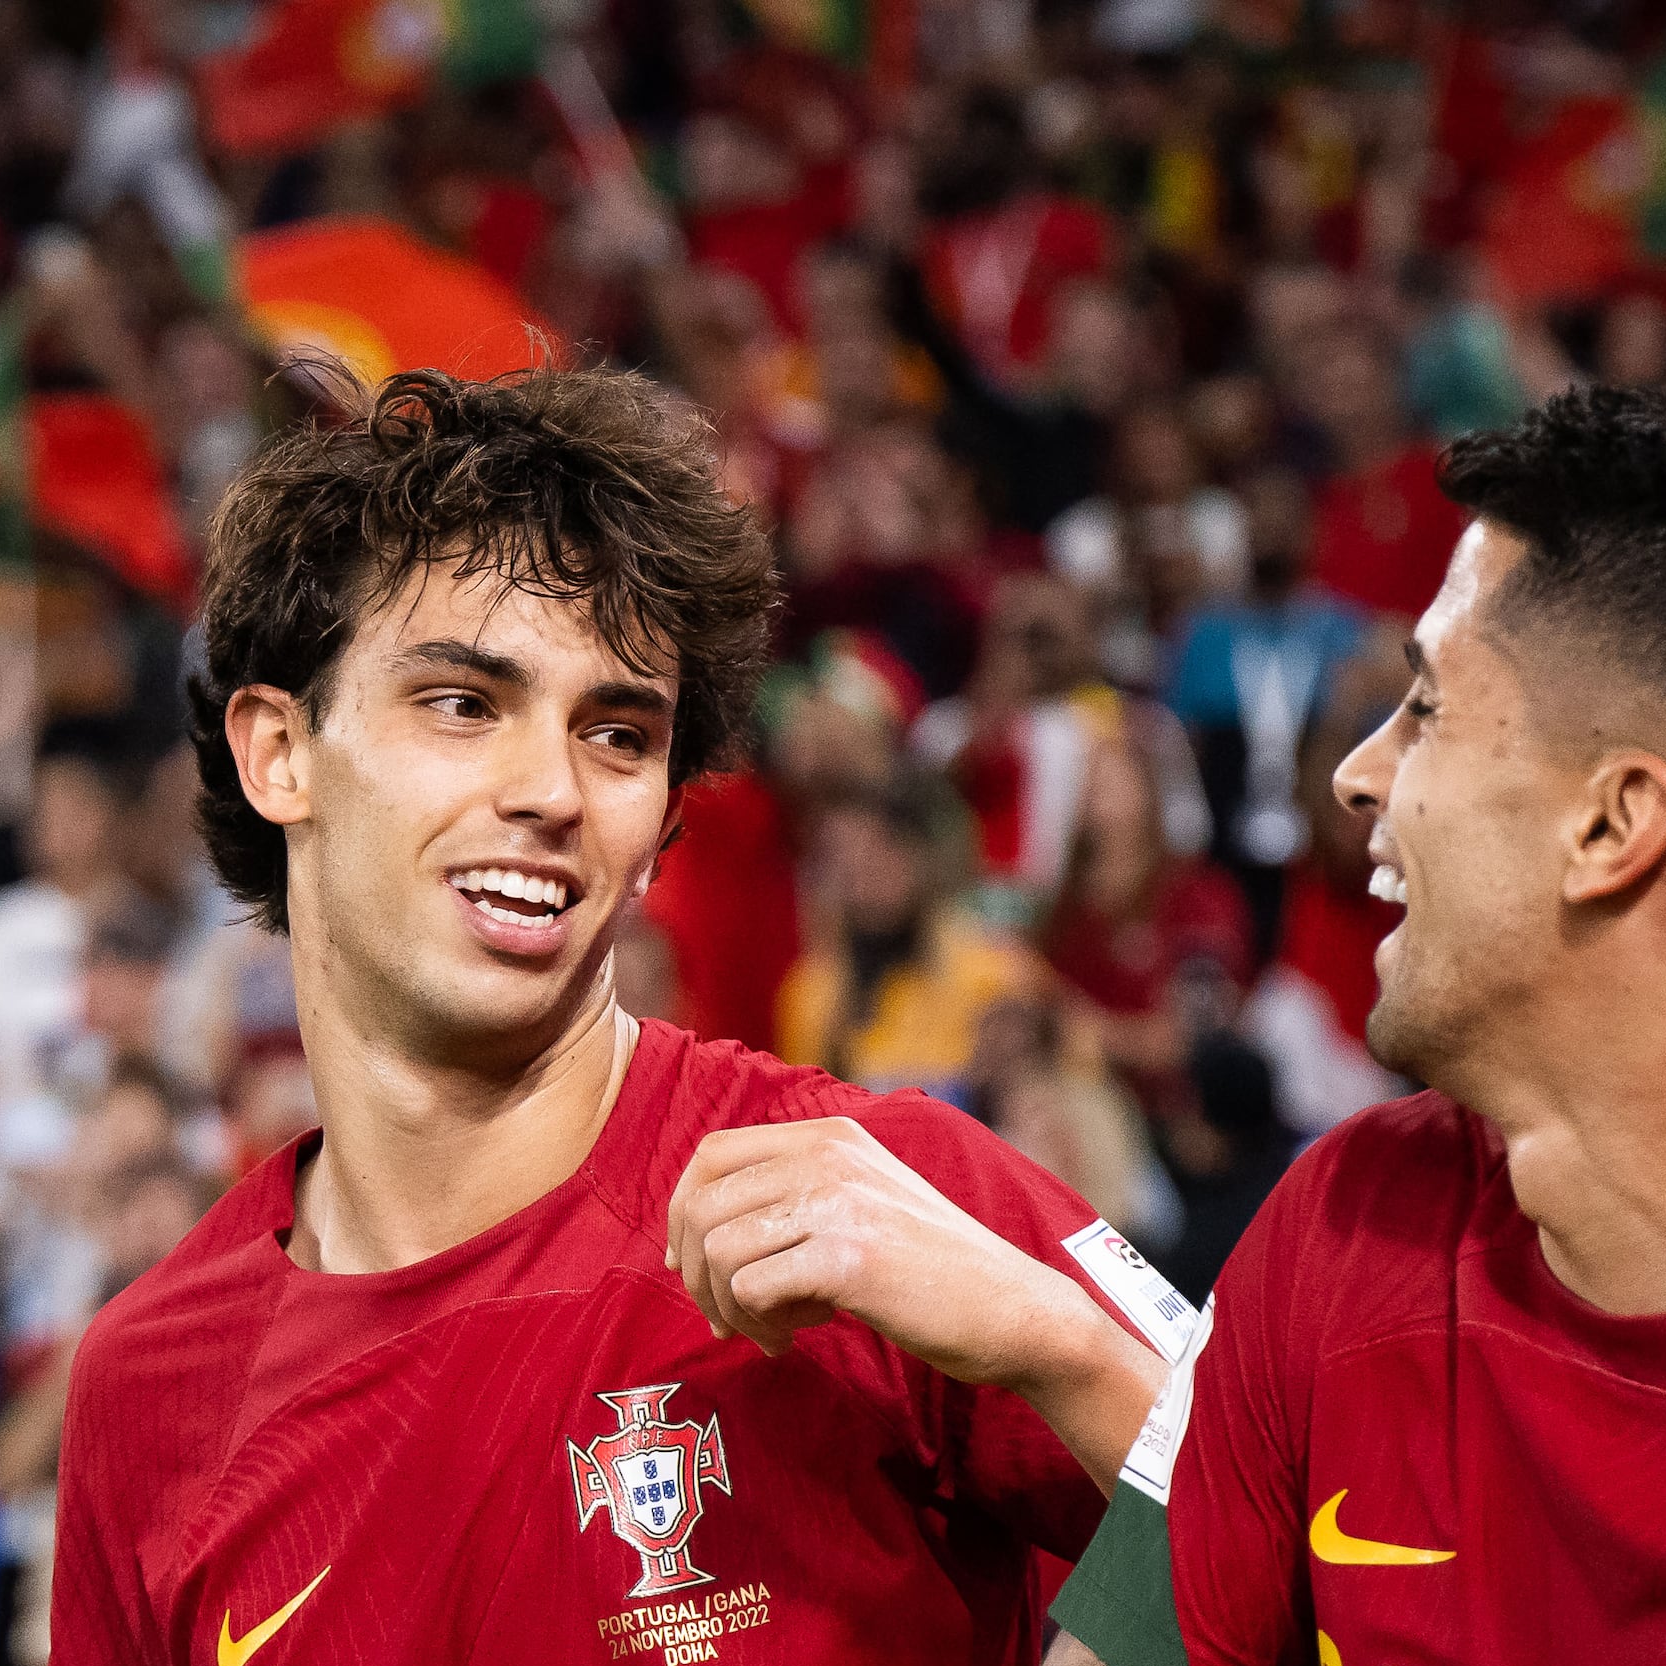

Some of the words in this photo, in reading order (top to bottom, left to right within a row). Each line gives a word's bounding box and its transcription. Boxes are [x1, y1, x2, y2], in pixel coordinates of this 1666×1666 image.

[598, 1600, 701, 1638] PORTUGAL
[713, 1582, 771, 1612] GANA
[608, 1635, 629, 1660] 24
[630, 1616, 724, 1655] NOVEMBRO
[725, 1604, 771, 1634] 2022
